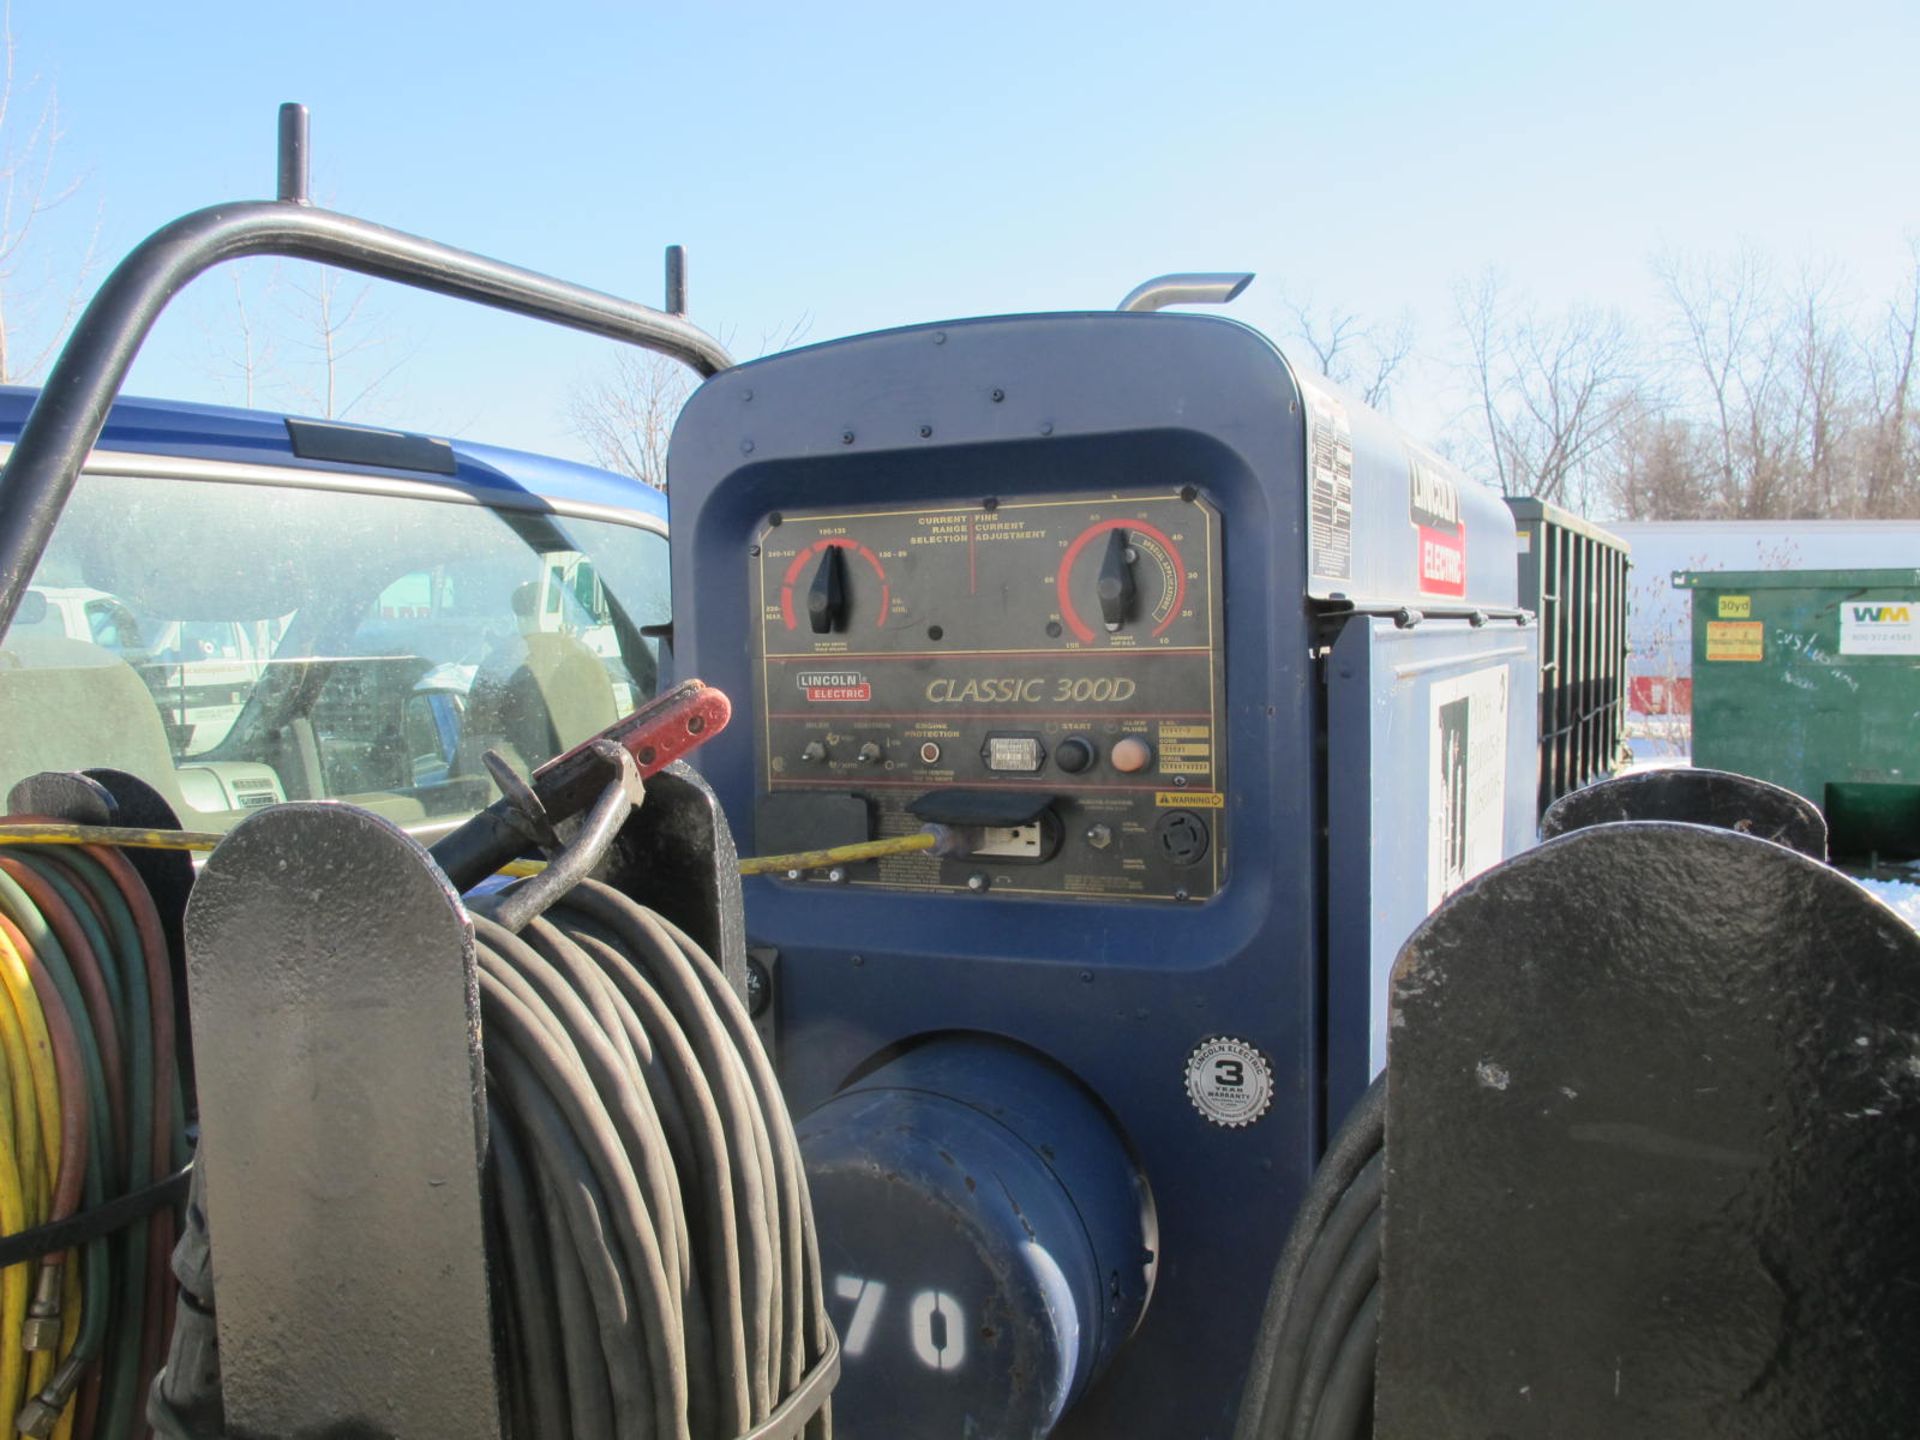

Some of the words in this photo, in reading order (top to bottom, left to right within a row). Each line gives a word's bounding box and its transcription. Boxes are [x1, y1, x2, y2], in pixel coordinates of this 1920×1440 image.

[918, 515, 967, 525] CURRENT
[974, 513, 998, 522] FINE
[932, 524, 967, 533] RANGE
[975, 521, 1025, 531] CURRENT
[910, 534, 967, 545] SELECTION
[975, 530, 1046, 541] ADJUSTMENT
[1721, 601, 1749, 612] 30yd
[1853, 607, 1910, 622] WM
[800, 675, 857, 686] LINCOLN
[814, 689, 865, 699] ELECTRIC
[925, 678, 1045, 702] CLASSIC
[1053, 677, 1136, 702] 300D
[1171, 796, 1211, 804] WARNING
[1195, 1045, 1225, 1070] LINCOLN
[1228, 1045, 1263, 1075] ELECTRIC
[1215, 1059, 1244, 1086] 3
